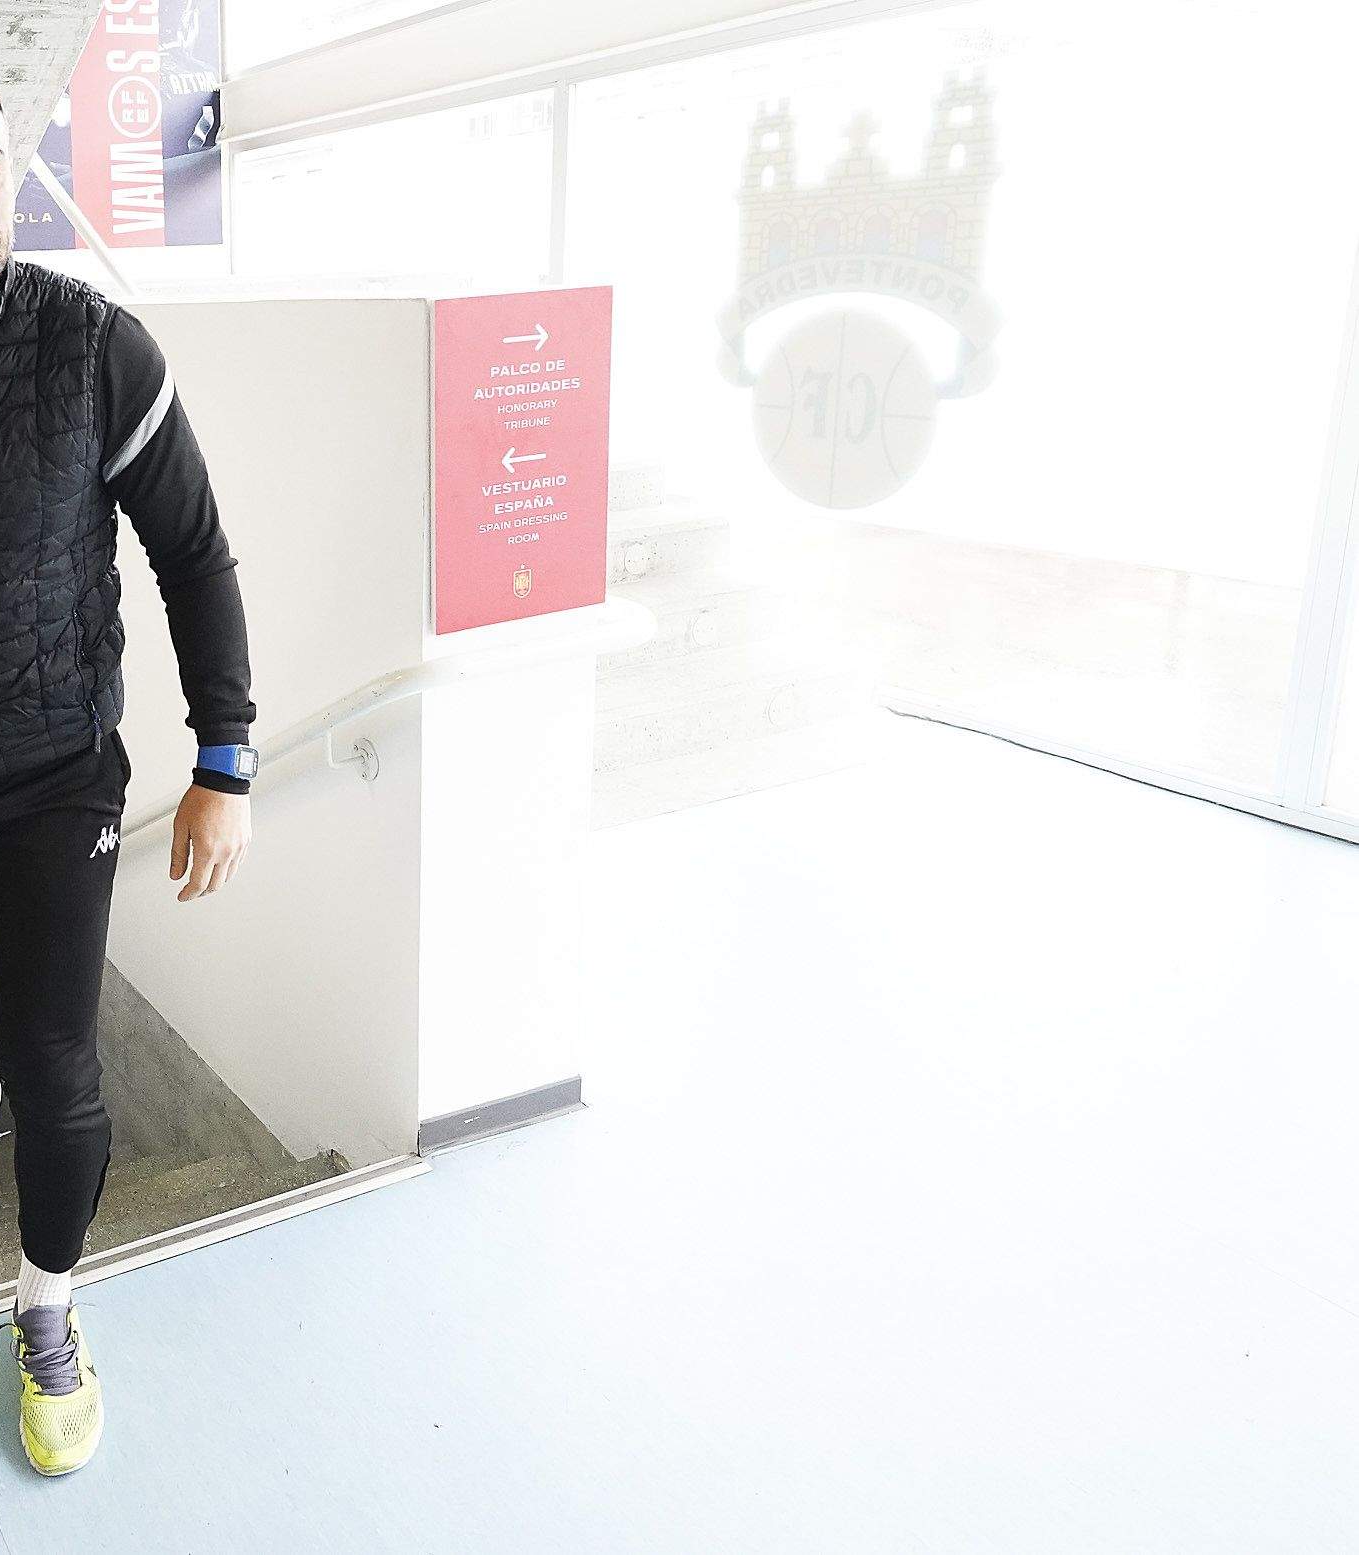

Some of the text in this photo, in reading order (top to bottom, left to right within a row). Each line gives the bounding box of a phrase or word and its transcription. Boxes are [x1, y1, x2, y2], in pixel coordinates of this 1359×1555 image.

[490, 359, 566, 378] PALCO DE
[473, 377, 581, 400] AUTORIDADES
[497, 399, 558, 413] HONORARY
[503, 416, 551, 430] TRIBUNE
[482, 475, 567, 497] VESTUARIO
[494, 494, 554, 515] ESPAÑA
[478, 511, 568, 533] SPAIN DRESSING
[507, 533, 540, 545] ROOM
